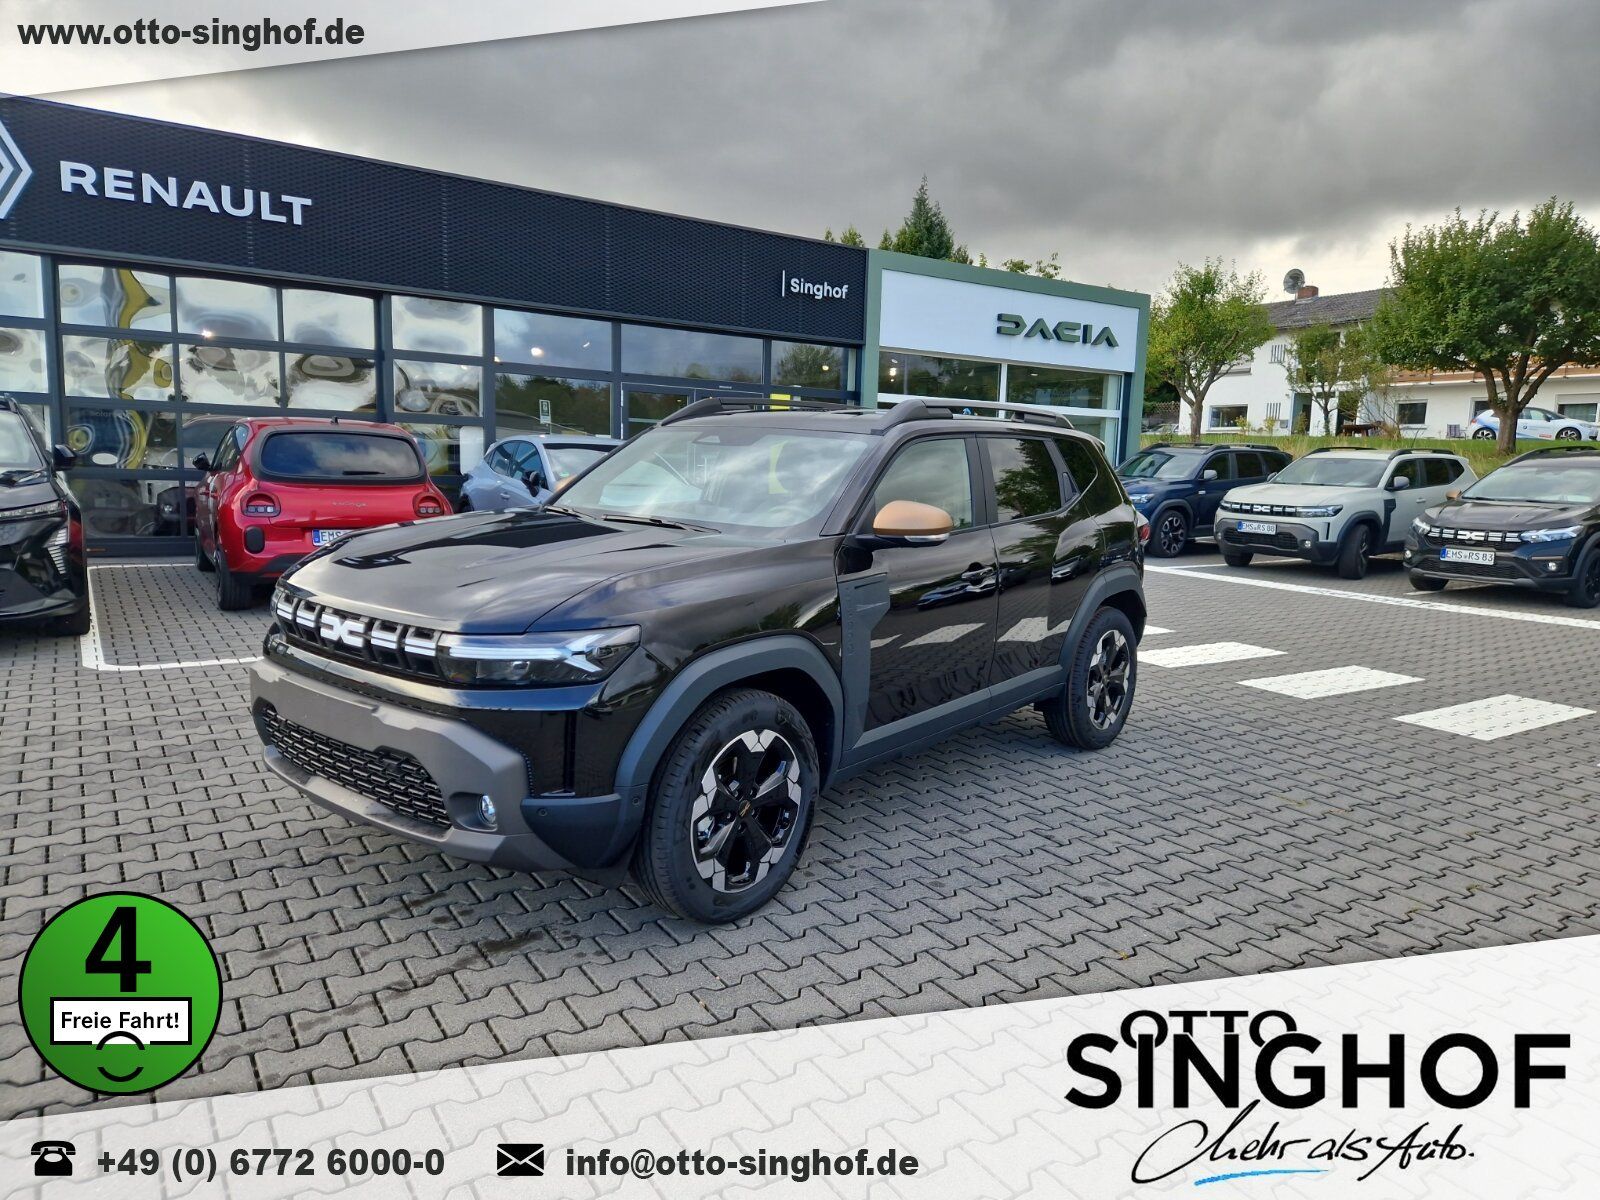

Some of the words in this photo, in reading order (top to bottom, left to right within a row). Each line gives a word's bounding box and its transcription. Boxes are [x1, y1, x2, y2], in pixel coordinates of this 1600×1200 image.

[59, 160, 312, 226] RENAULT
[790, 277, 849, 299] Singhof
[997, 313, 1120, 347] DACIA
[1446, 550, 1463, 559] EMS
[1468, 552, 1480, 560] RS
[1482, 553, 1493, 562] 83
